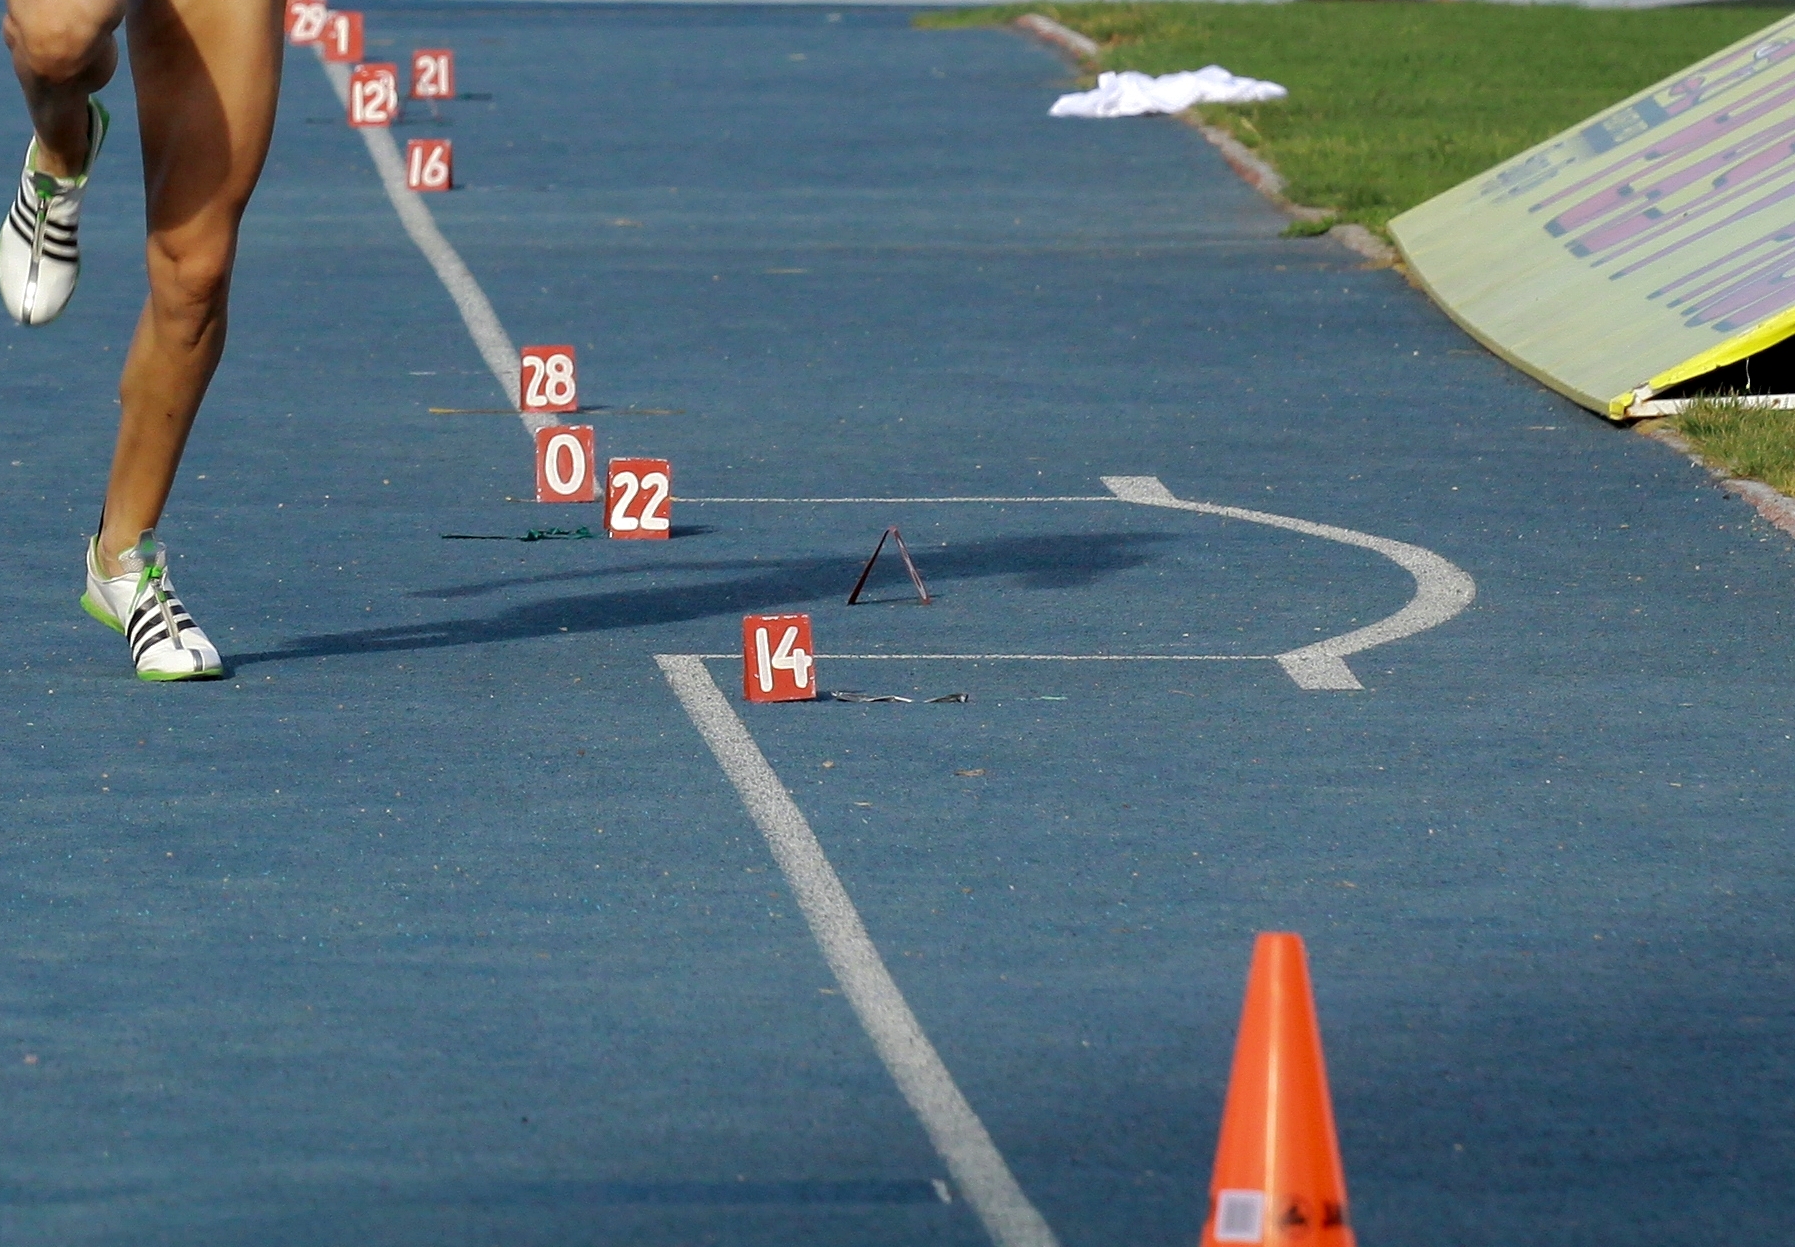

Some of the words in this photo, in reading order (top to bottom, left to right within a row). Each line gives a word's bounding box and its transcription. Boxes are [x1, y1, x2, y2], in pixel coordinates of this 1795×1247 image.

[414, 54, 450, 96] 21
[408, 145, 448, 187] 16
[521, 353, 577, 408] 28
[544, 433, 587, 496] 0
[609, 471, 671, 532] 22
[754, 625, 813, 694] 14
